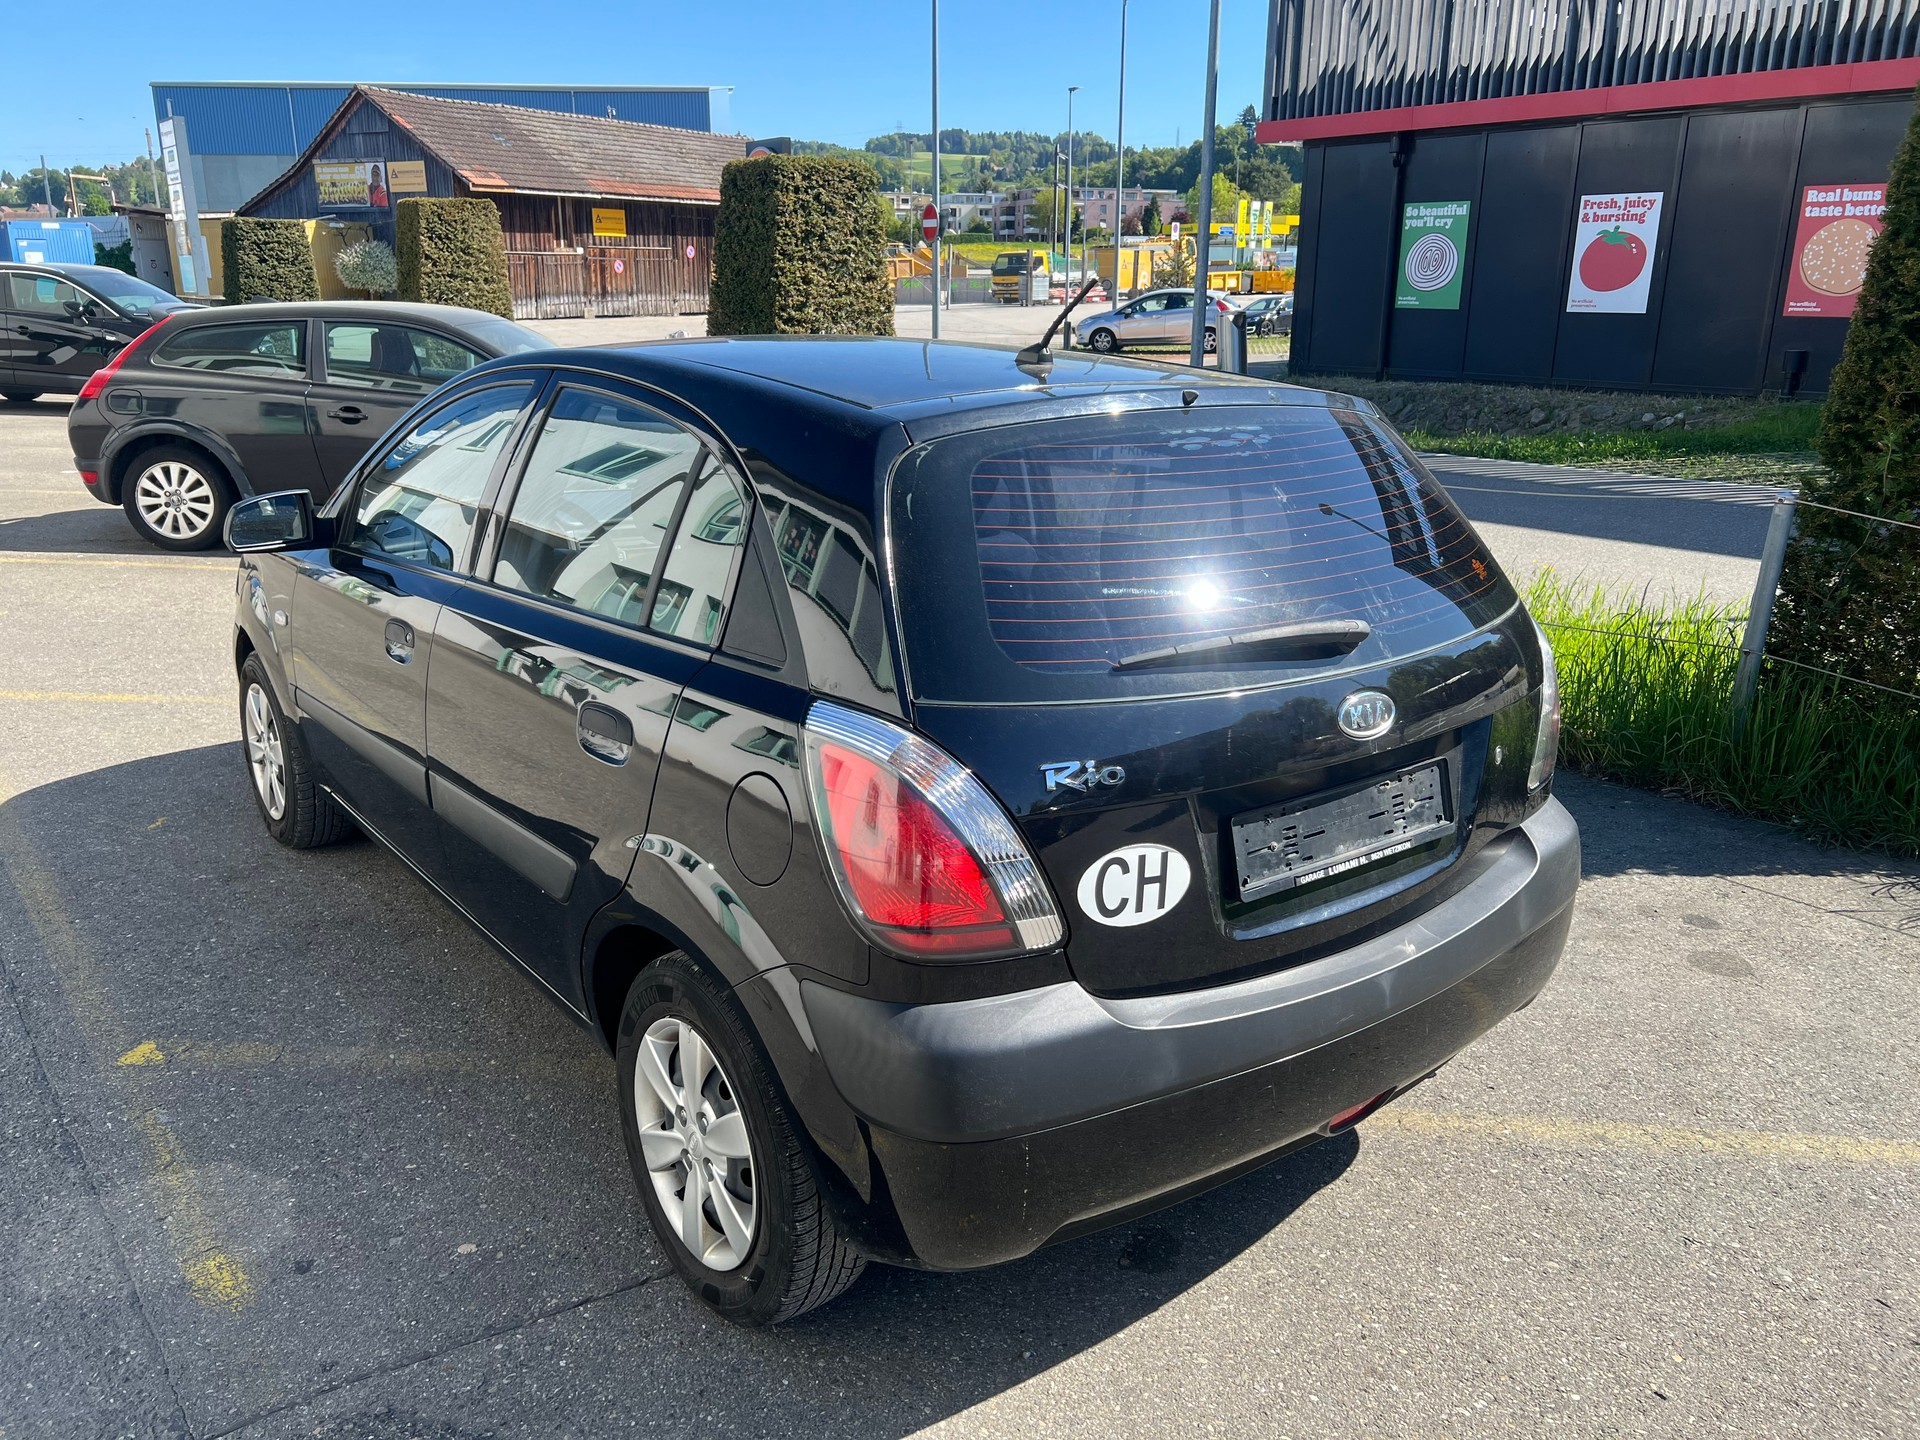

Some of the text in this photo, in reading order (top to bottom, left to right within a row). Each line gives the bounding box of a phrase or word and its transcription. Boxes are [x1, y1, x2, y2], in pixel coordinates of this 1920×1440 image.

[1806, 188, 1882, 202] Real buns
[1406, 204, 1467, 216] So beautiful
[1583, 196, 1656, 211] Fresh, juicy
[1805, 203, 1888, 217] taste bette
[1405, 217, 1453, 230] you'll cry
[1581, 210, 1647, 224] & bursting
[1349, 700, 1389, 729] KIA
[1040, 760, 1126, 793] Rio
[1300, 869, 1325, 884] GARAGE
[1328, 858, 1359, 876] LUMANI
[1360, 855, 1369, 865] H.
[1383, 840, 1411, 857] WETZIKON
[1094, 850, 1169, 919] CH
